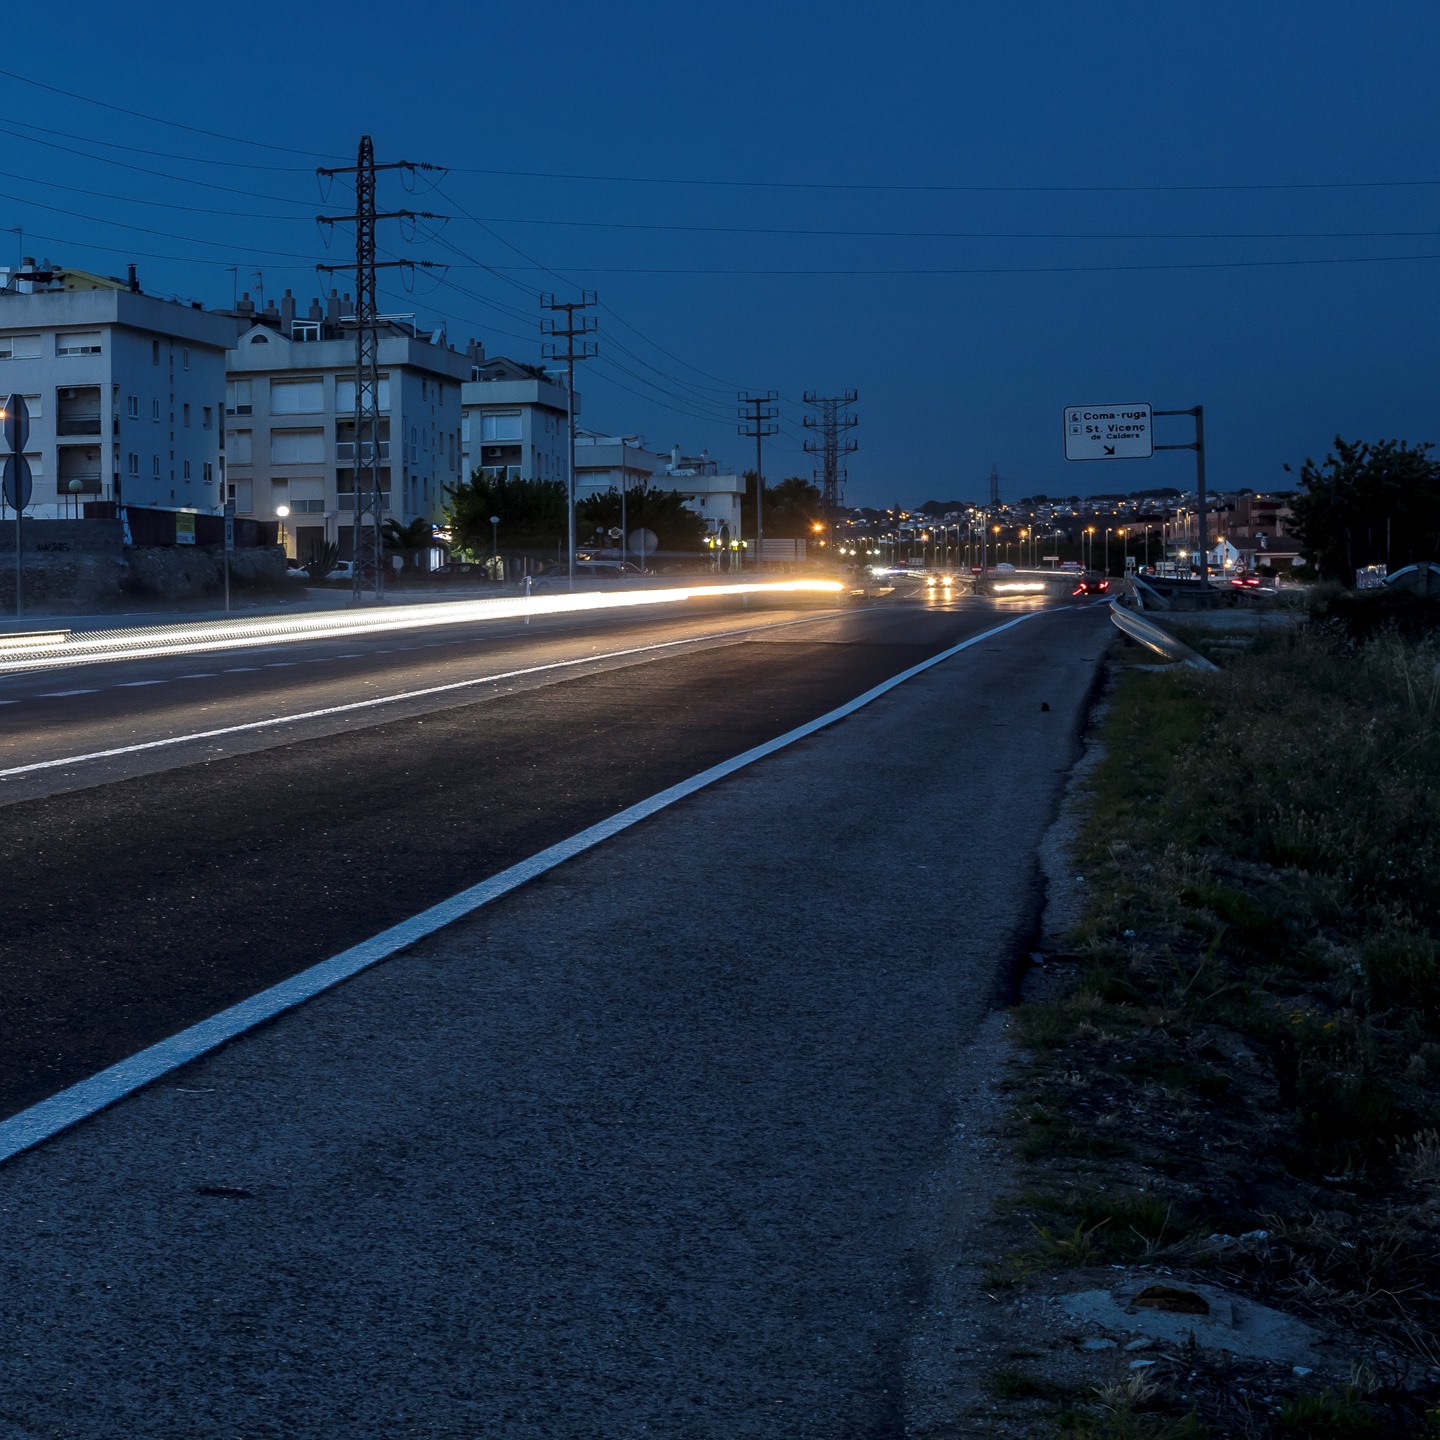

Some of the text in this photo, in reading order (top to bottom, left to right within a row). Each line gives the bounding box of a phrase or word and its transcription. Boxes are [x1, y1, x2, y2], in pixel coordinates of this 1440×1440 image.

[1083, 411, 1147, 421] Coma-ruga
[1085, 424, 1146, 433] St. Vicenç
